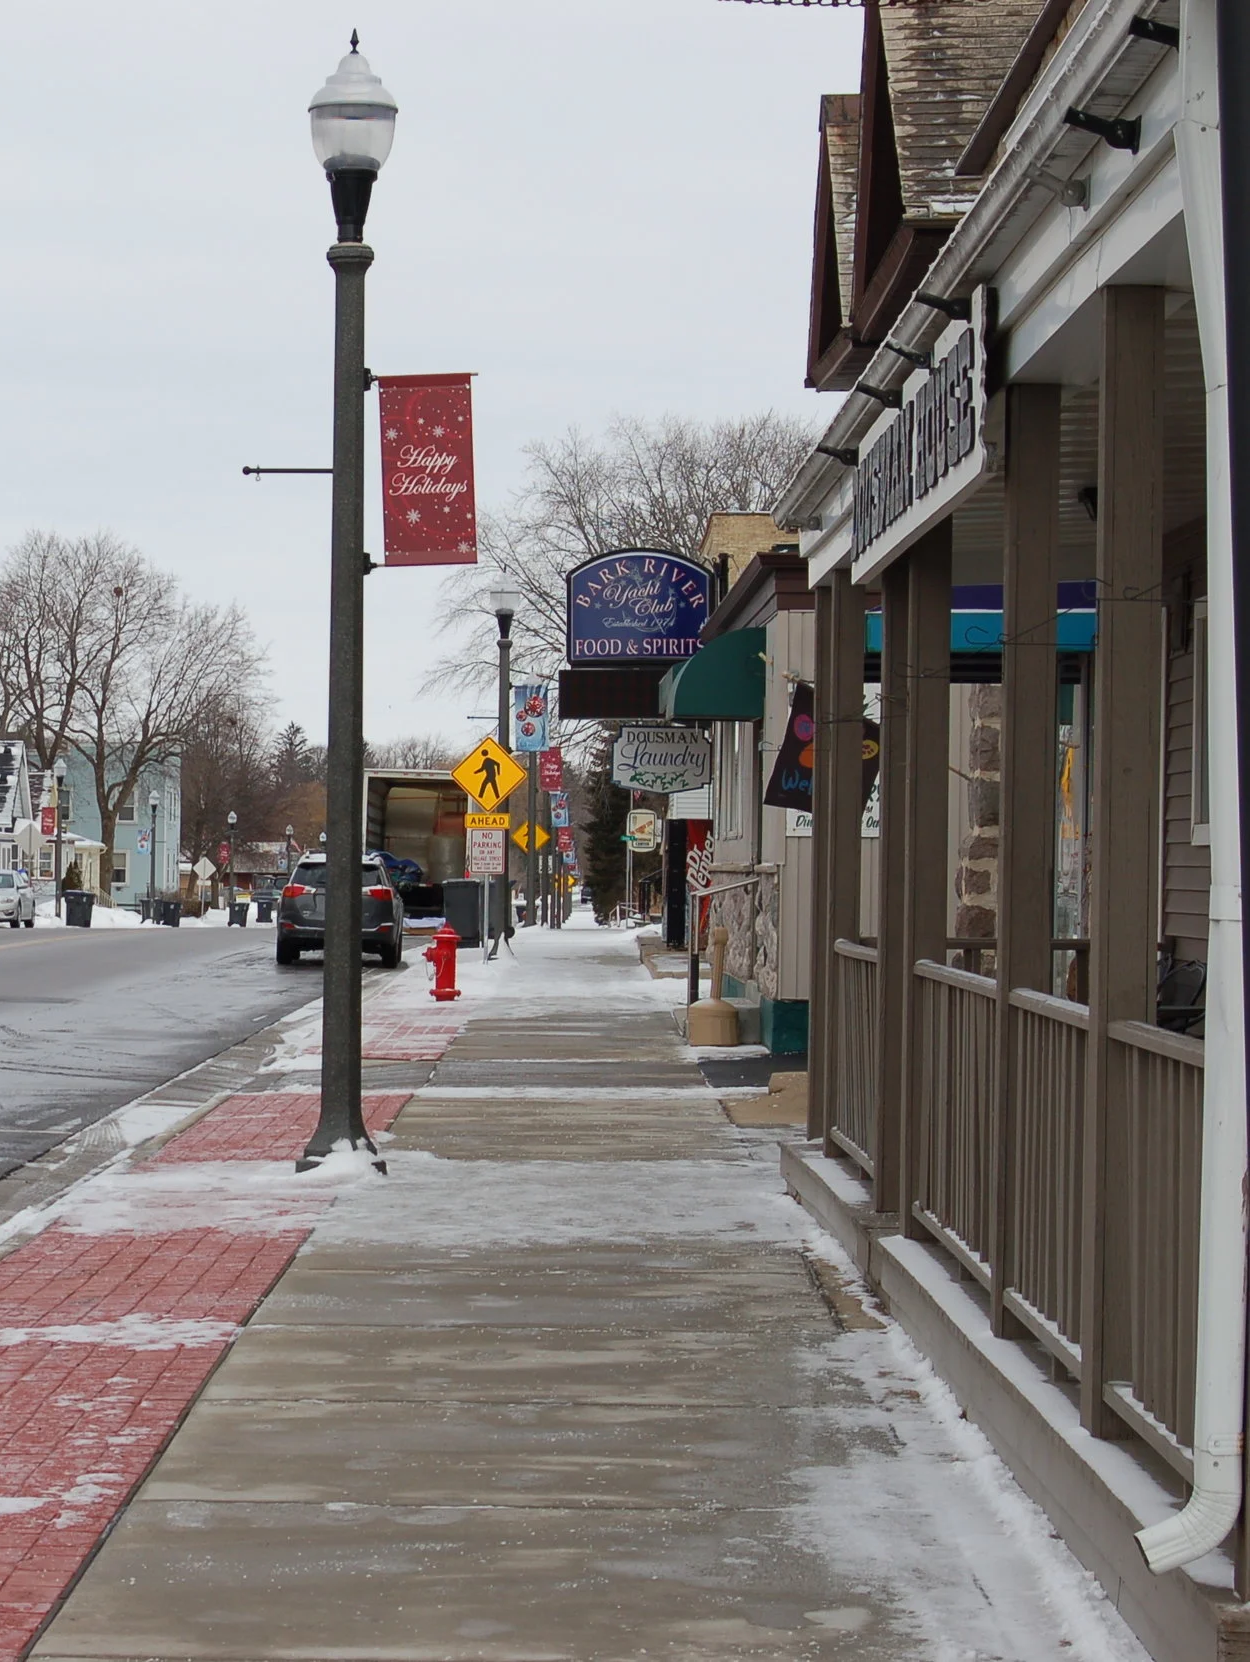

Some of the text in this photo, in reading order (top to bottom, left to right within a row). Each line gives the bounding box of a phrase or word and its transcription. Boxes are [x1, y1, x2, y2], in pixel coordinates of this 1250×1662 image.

[914, 328, 976, 500] HOUSE
[397, 444, 458, 475] Happy
[389, 472, 468, 502] Holidays
[576, 558, 705, 609] BARK RIVER
[603, 580, 661, 609] Yacht
[629, 596, 674, 617] Club
[575, 638, 622, 655] FOOD
[626, 639, 639, 655] &
[627, 731, 699, 744] DOUSMAN
[617, 739, 707, 778] Laundry
[470, 816, 506, 826] AHEAD
[473, 841, 502, 849] PARKING
[481, 832, 493, 840] NO
[686, 843, 703, 872] Dr
[686, 829, 715, 890] Pepper
